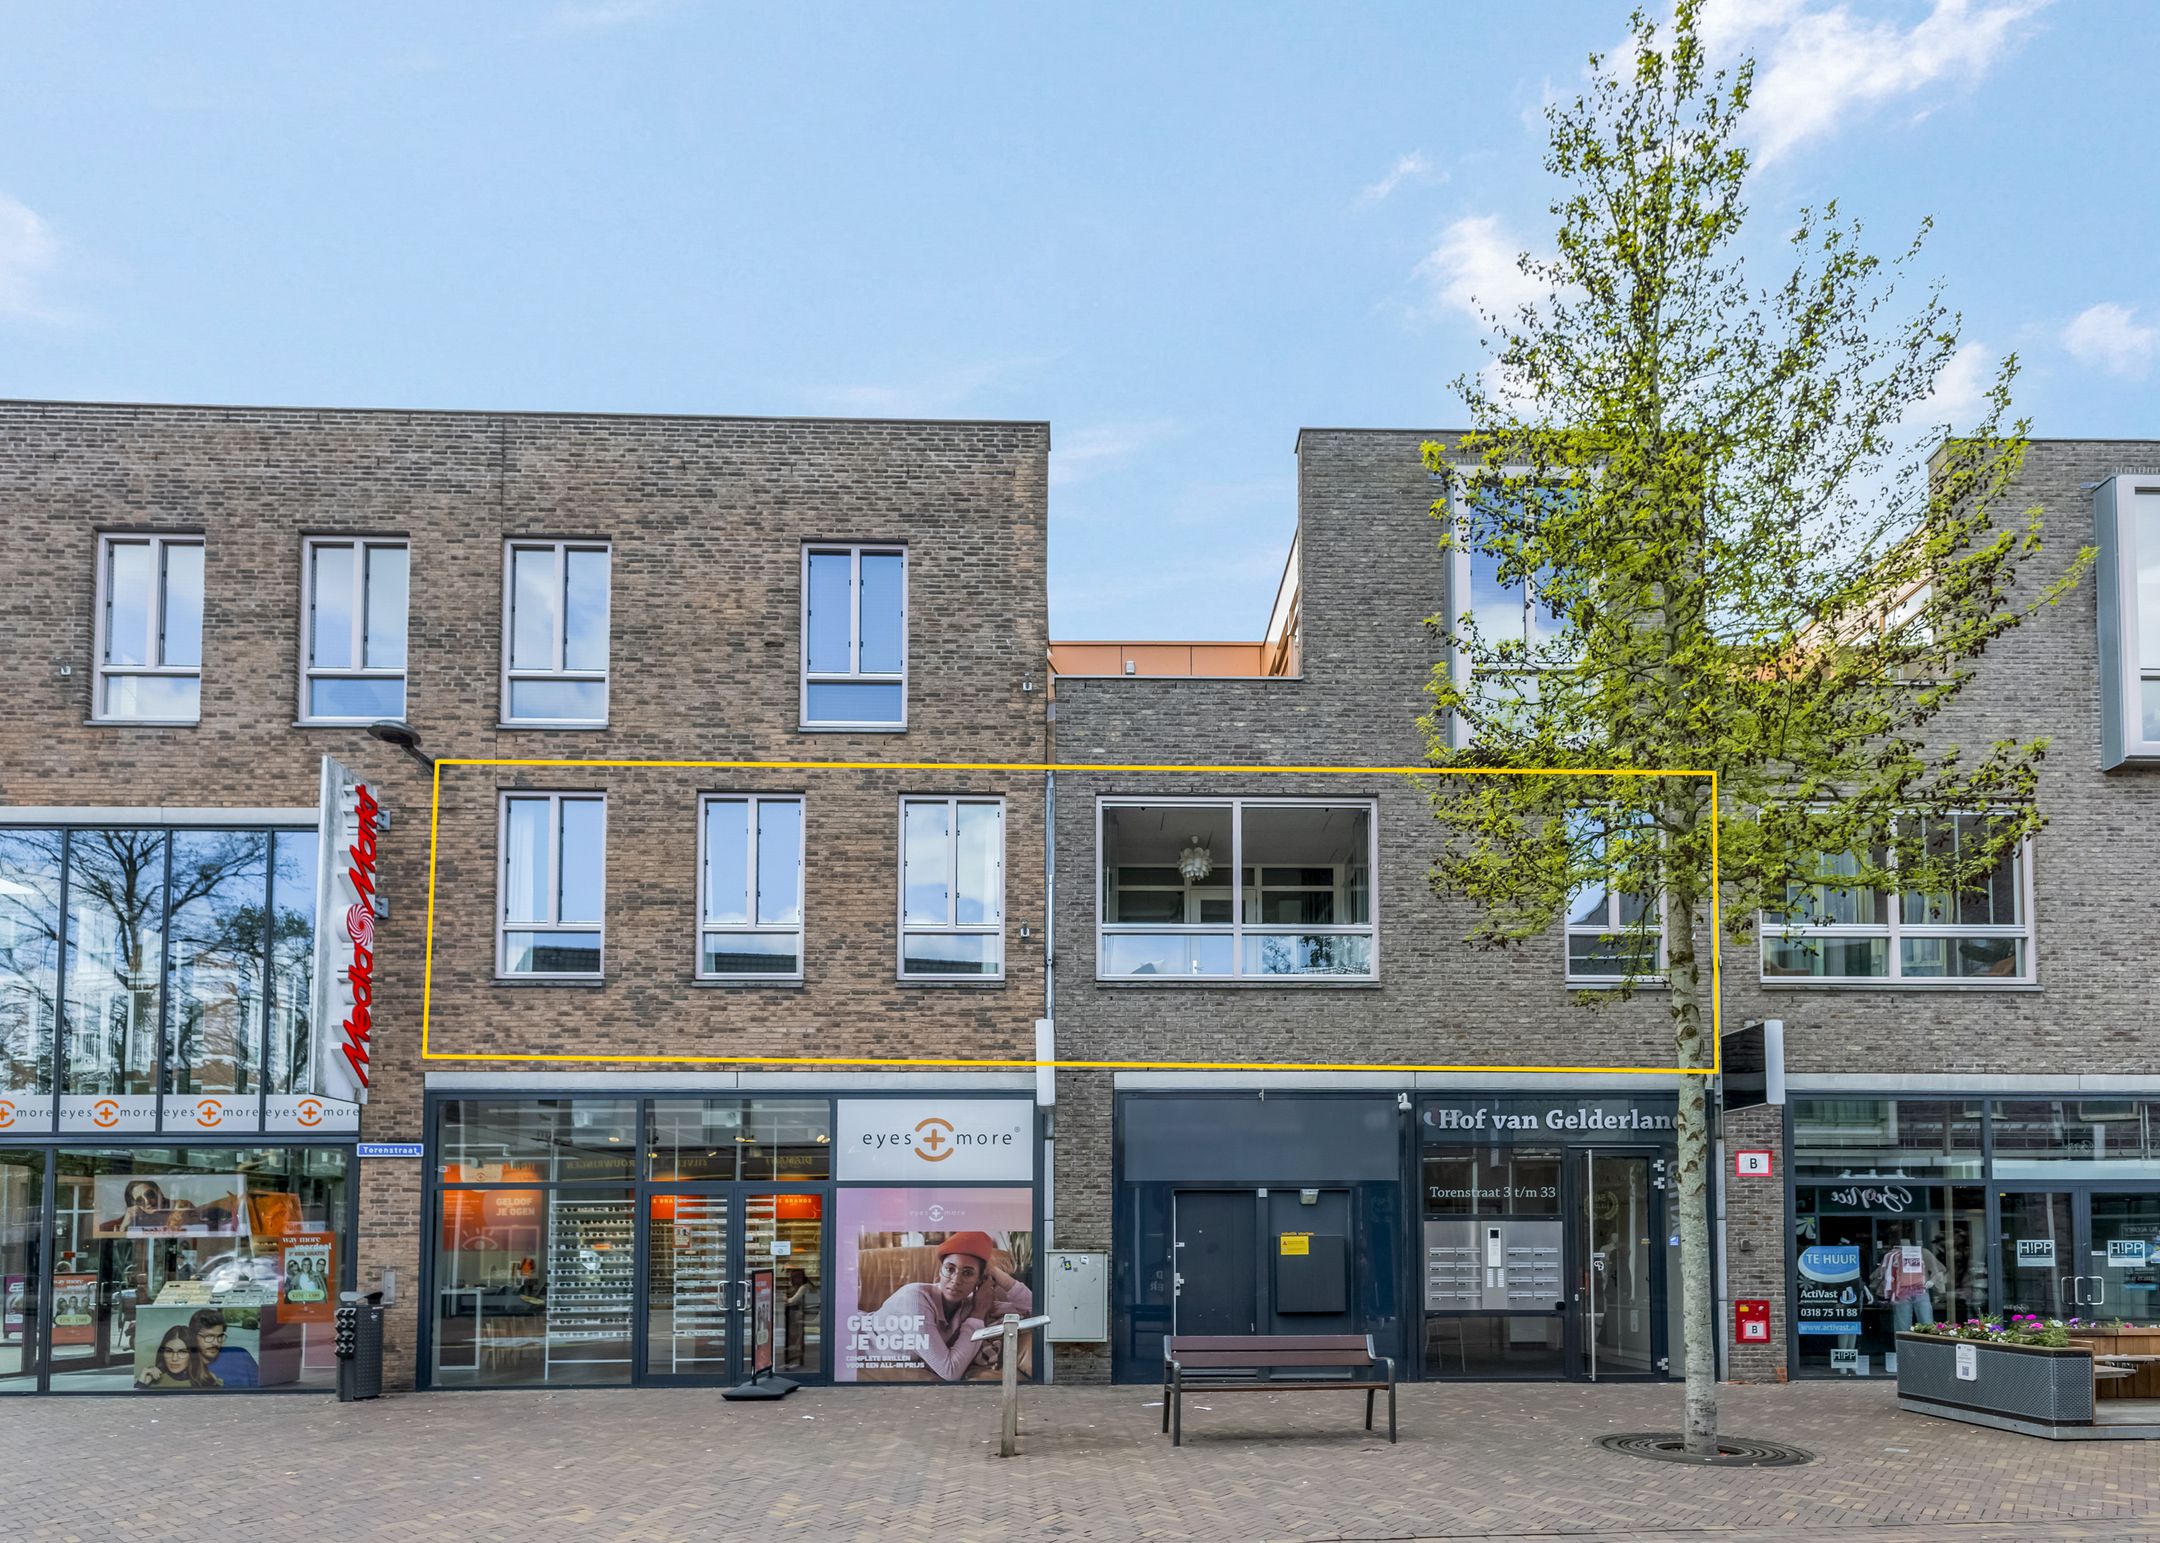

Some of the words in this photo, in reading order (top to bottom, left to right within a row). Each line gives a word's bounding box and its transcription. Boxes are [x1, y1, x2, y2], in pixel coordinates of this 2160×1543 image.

[348, 784, 378, 917] Markt
[342, 942, 373, 1088] Media
[16, 1108, 53, 1118] more
[60, 1108, 93, 1120] eyes
[120, 1108, 157, 1118] more
[163, 1108, 196, 1119] eyes
[222, 1107, 260, 1117] more
[265, 1107, 297, 1119] eyes
[323, 1107, 360, 1117] more
[1438, 1108, 1487, 1130] Hof
[1492, 1113, 1539, 1130] van
[862, 1133, 912, 1149] eyes
[956, 1133, 1013, 1145] more
[363, 1146, 418, 1154] Torenstraat
[1750, 1158, 1758, 1169] B
[1429, 1186, 1501, 1199] Torenstraat
[1503, 1187, 1511, 1199] 3
[1514, 1186, 1538, 1198] t/m
[1540, 1187, 1556, 1198] 33
[495, 1197, 533, 1207] GELOOF
[495, 1207, 507, 1216] JE
[508, 1207, 535, 1216] OGEN
[909, 1209, 929, 1217] eyes
[282, 1236, 297, 1244] way
[2019, 1242, 2053, 1254] H!PP
[2110, 1242, 2143, 1254] H!PP
[1806, 1254, 1820, 1264] TE
[1823, 1254, 1857, 1264] HUUR
[1800, 1289, 1838, 1298] ActiVast
[1800, 1308, 1821, 1317] 0318
[1823, 1308, 1834, 1317] 75
[1836, 1308, 1844, 1317] 11
[1846, 1308, 1858, 1317] 88
[847, 1315, 925, 1332] GELOOF
[1801, 1323, 1858, 1332] www.activast.nl
[1751, 1325, 1758, 1334] B
[845, 1333, 870, 1351] JE
[875, 1333, 930, 1351] OGEN
